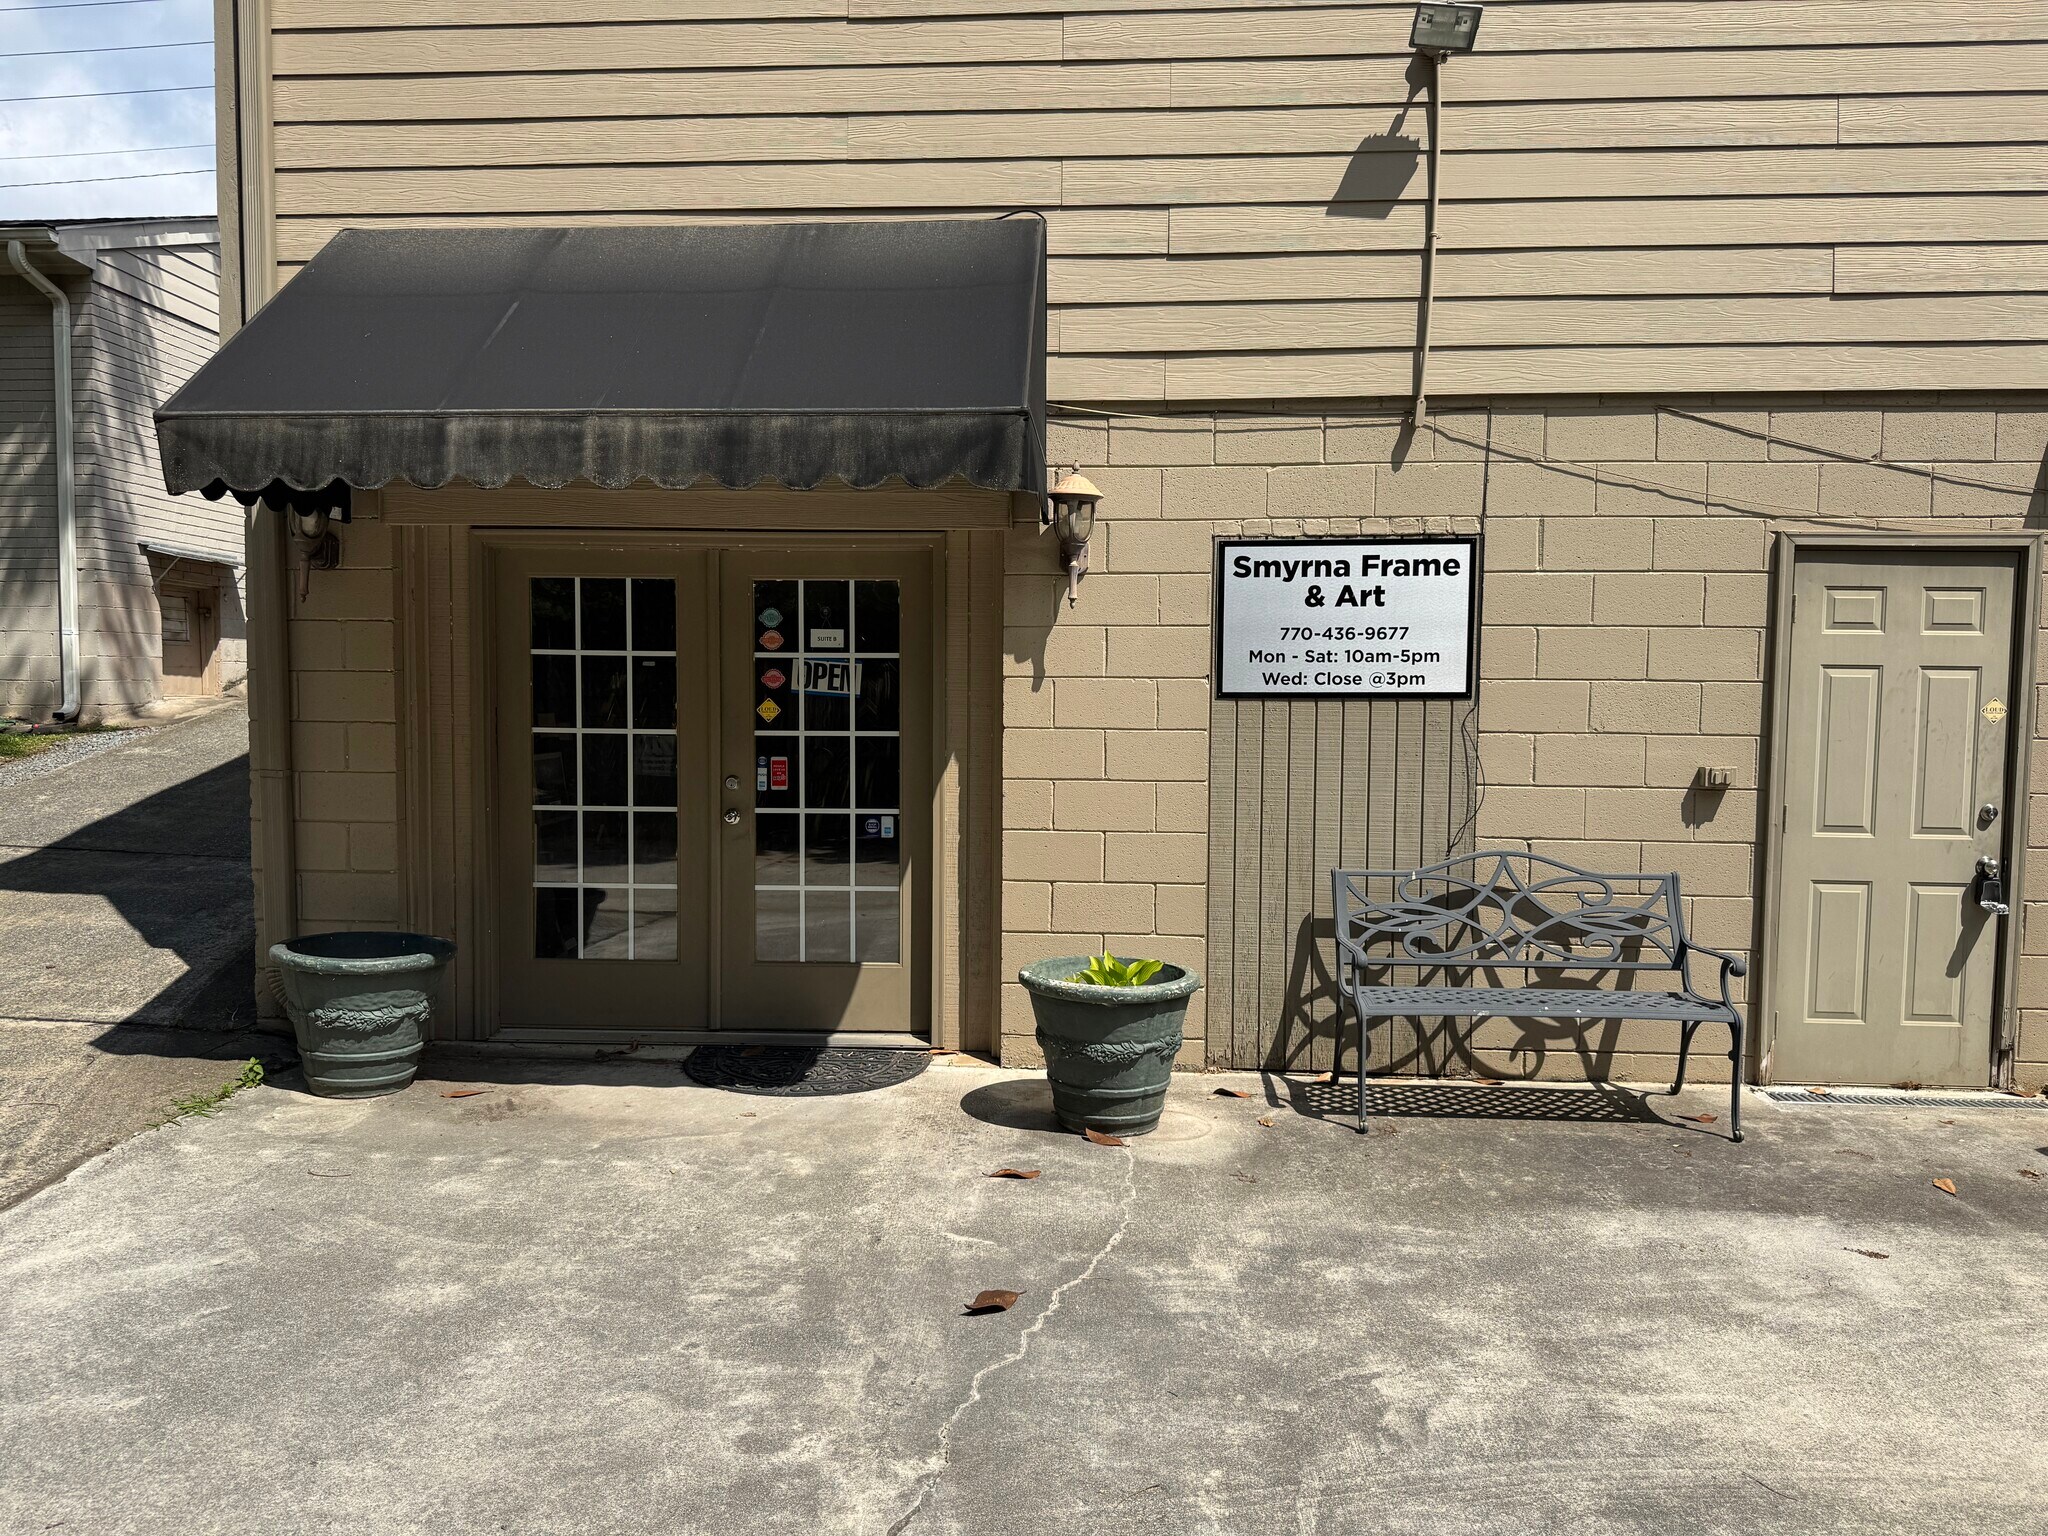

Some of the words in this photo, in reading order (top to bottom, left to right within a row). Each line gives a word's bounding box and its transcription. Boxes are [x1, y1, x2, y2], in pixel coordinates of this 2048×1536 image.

[1233, 555, 1350, 583] Smyrna
[1362, 554, 1461, 577] Frame
[1304, 585, 1326, 608] &
[1335, 585, 1386, 607] Art
[1280, 627, 1409, 641] 770-436-9677
[1249, 650, 1286, 663] Mon
[1304, 650, 1338, 663] Sat:
[1344, 650, 1440, 666] 10am-5pm
[797, 660, 857, 692] OPEN
[1262, 672, 1307, 686] Wed:
[1314, 671, 1362, 686] Close
[1368, 671, 1426, 688] @3pm
